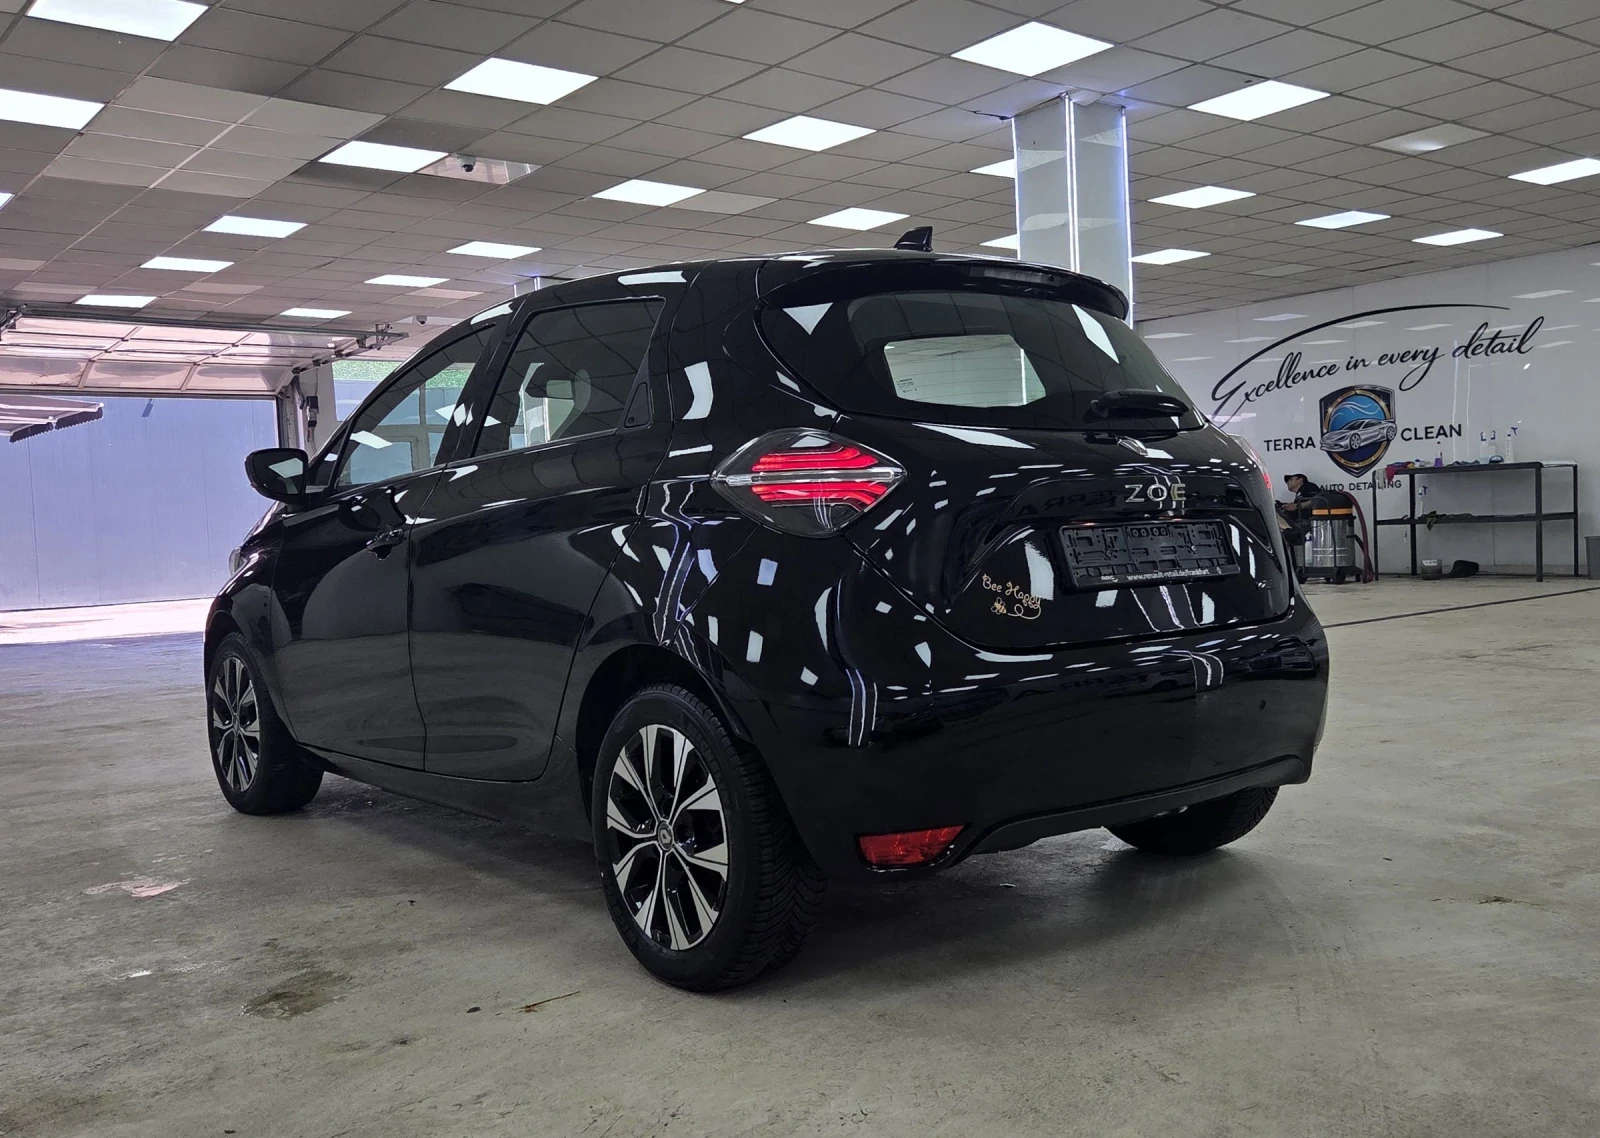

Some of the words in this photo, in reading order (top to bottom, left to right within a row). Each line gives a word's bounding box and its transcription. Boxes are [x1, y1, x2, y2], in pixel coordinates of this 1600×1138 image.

[1345, 355, 1371, 371] in
[1378, 347, 1445, 391] every
[1452, 316, 1544, 359] detail
[1264, 436, 1316, 452] TERRA
[1400, 424, 1462, 442] CLEAN
[1124, 483, 1187, 503] ZOE
[1319, 483, 1345, 491] AUTO
[1348, 480, 1402, 491] DETALING
[981, 573, 1003, 593] Bee
[1005, 580, 1041, 610] Happy
